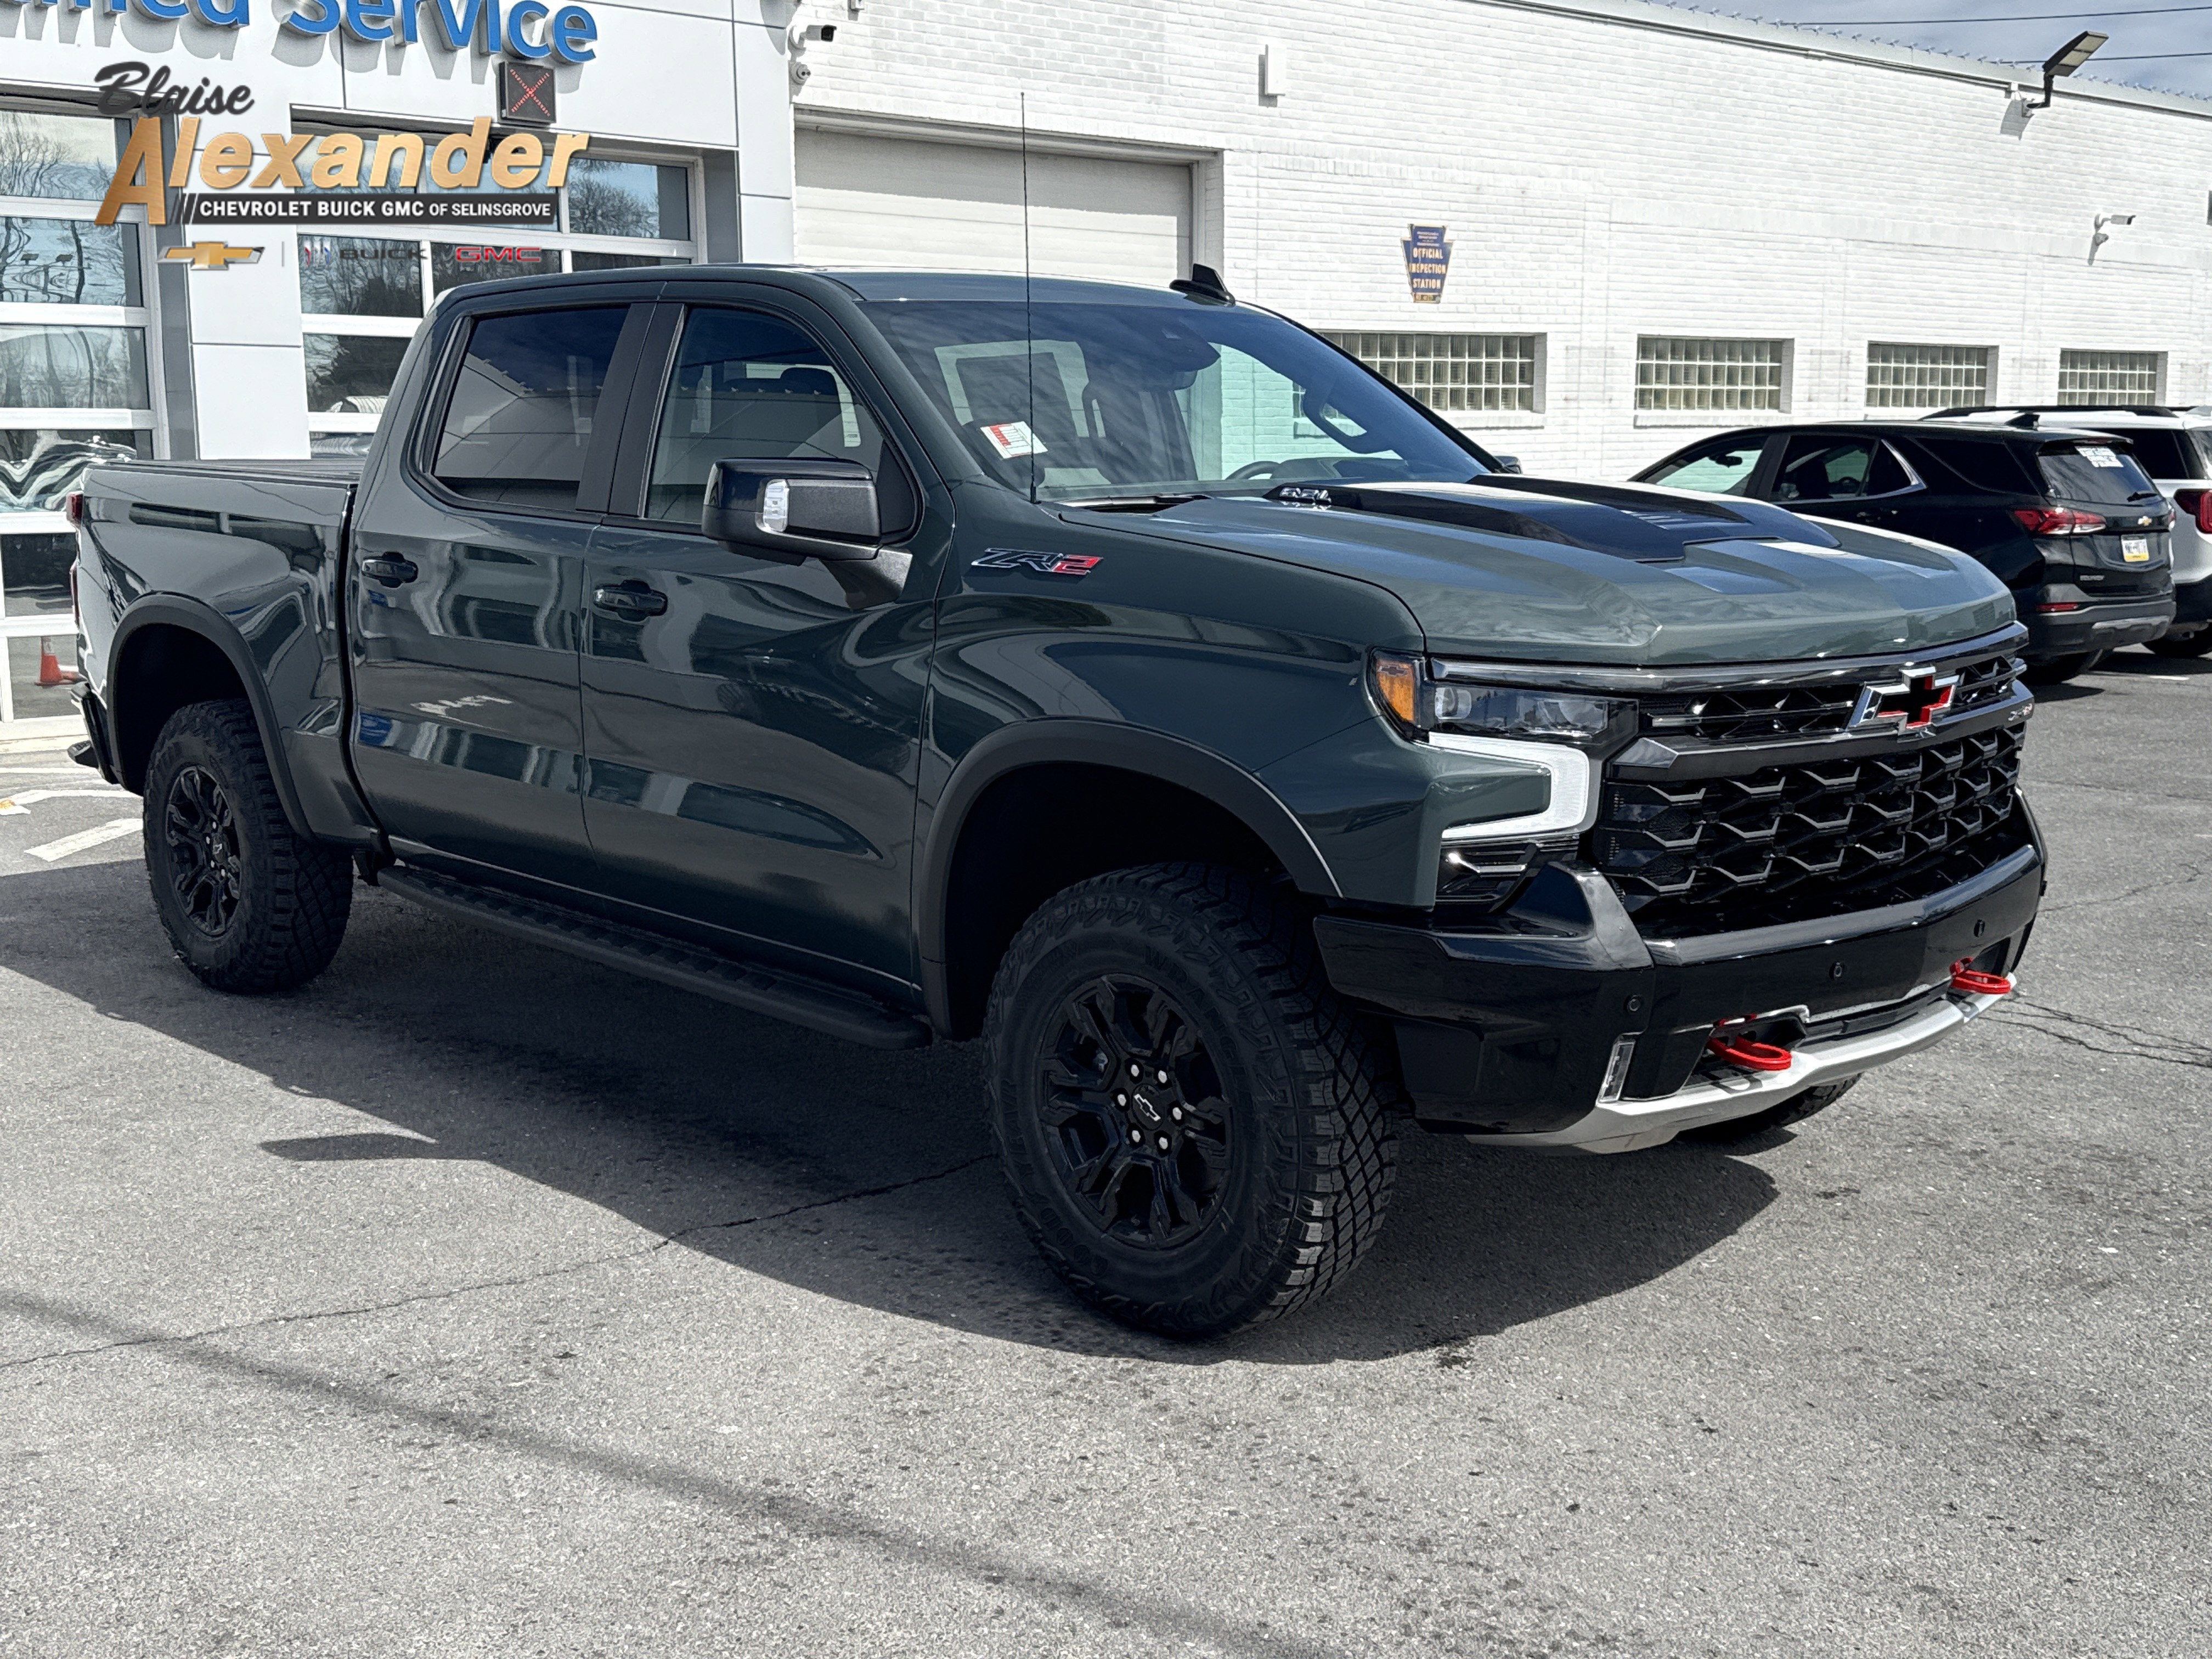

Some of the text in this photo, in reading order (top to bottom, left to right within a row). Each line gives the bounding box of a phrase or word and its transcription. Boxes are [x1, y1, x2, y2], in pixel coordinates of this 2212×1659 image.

[1413, 248, 1443, 259] OFFICIAL
[1409, 263, 1446, 274] INSPECTION
[1413, 278, 1441, 289] STATION
[971, 548, 1103, 575] ZR2
